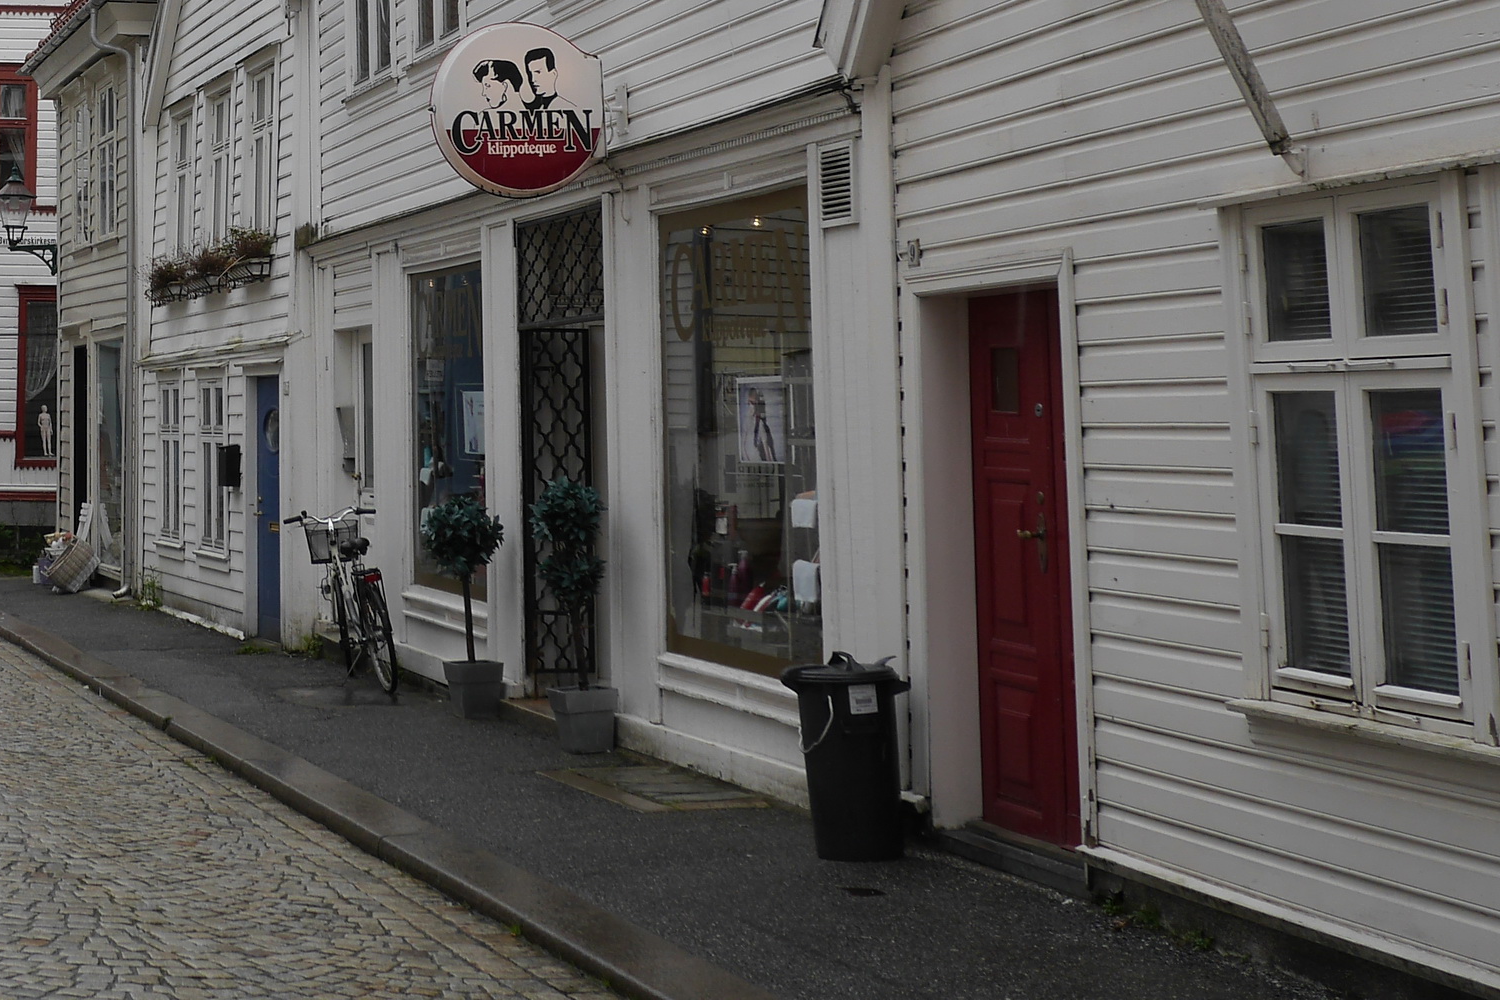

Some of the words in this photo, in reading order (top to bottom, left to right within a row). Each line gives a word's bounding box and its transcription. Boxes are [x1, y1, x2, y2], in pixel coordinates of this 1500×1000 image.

[451, 109, 593, 155] CARMEN
[487, 141, 557, 158] klippoteque
[910, 244, 915, 262] 9
[671, 223, 807, 342] CARMEN
